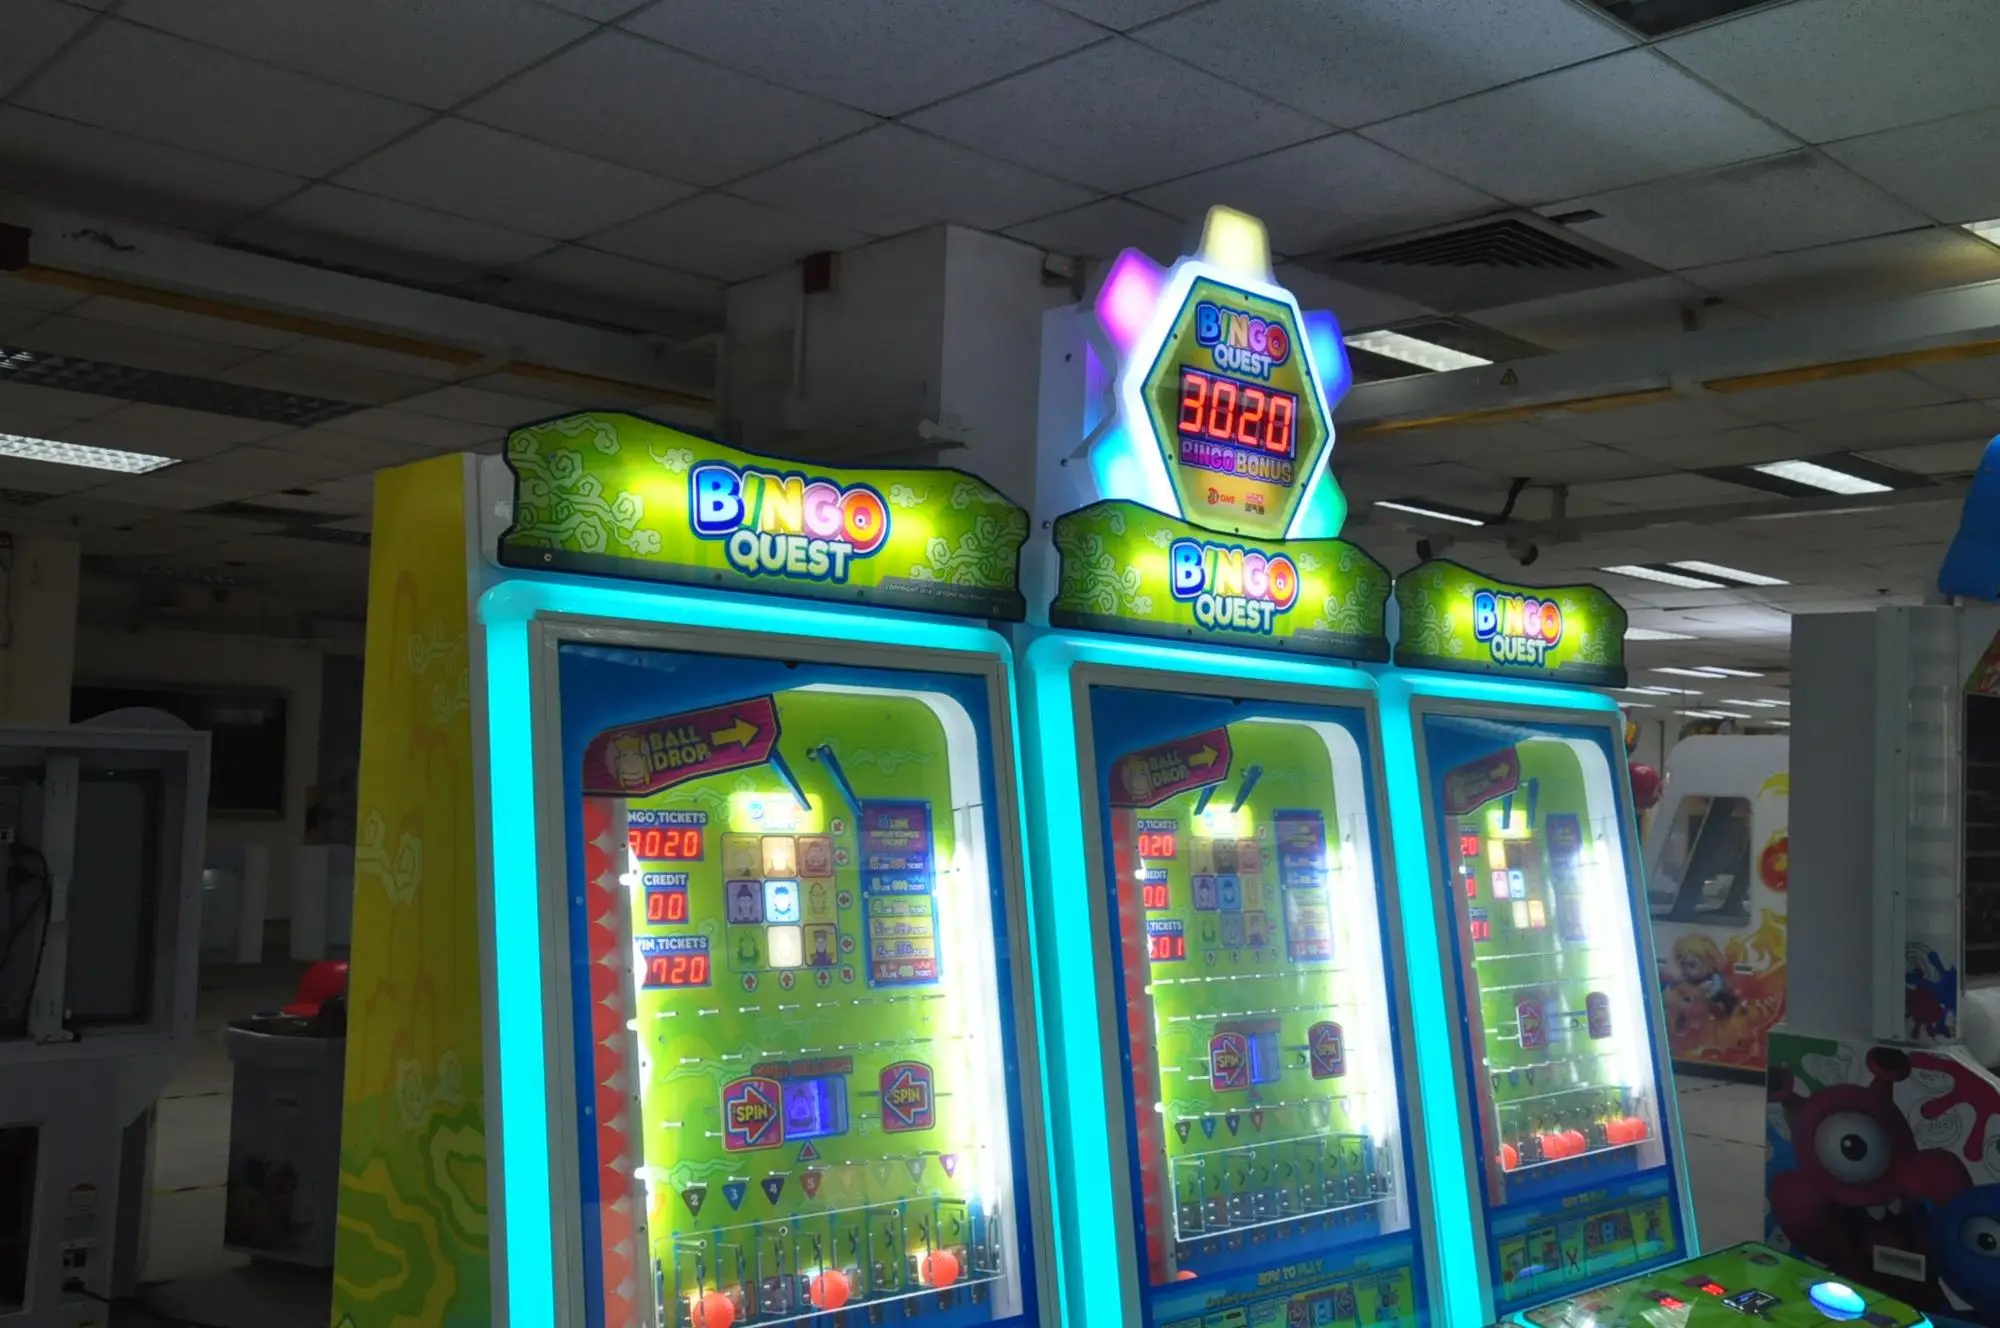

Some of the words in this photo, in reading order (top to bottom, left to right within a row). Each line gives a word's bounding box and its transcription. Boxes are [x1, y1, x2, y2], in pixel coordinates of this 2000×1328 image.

[1197, 304, 1289, 363] BINGO
[1215, 346, 1273, 377] QUEST
[1180, 373, 1292, 454] 3020
[1182, 440, 1235, 472] BINGO
[1236, 451, 1292, 483] BONUS
[693, 465, 888, 552] BINGO
[729, 532, 854, 578] QUEST
[1172, 541, 1298, 609] BINGO
[1195, 594, 1276, 635] QUEST
[1474, 592, 1562, 647] BINGO
[1491, 636, 1546, 666] QUEST
[649, 726, 700, 751] BALL
[653, 746, 711, 771] DROP
[1150, 749, 1183, 771] BALL
[658, 811, 707, 824] TICKETS
[643, 874, 687, 886] CREDIT
[648, 893, 685, 920] 00
[657, 937, 707, 950] TICKETS
[891, 1089, 921, 1104] SPIN
[735, 1105, 768, 1123] SPIN
[690, 1194, 699, 1206] 2
[730, 1188, 738, 1200] 3
[769, 1183, 778, 1195] 4
